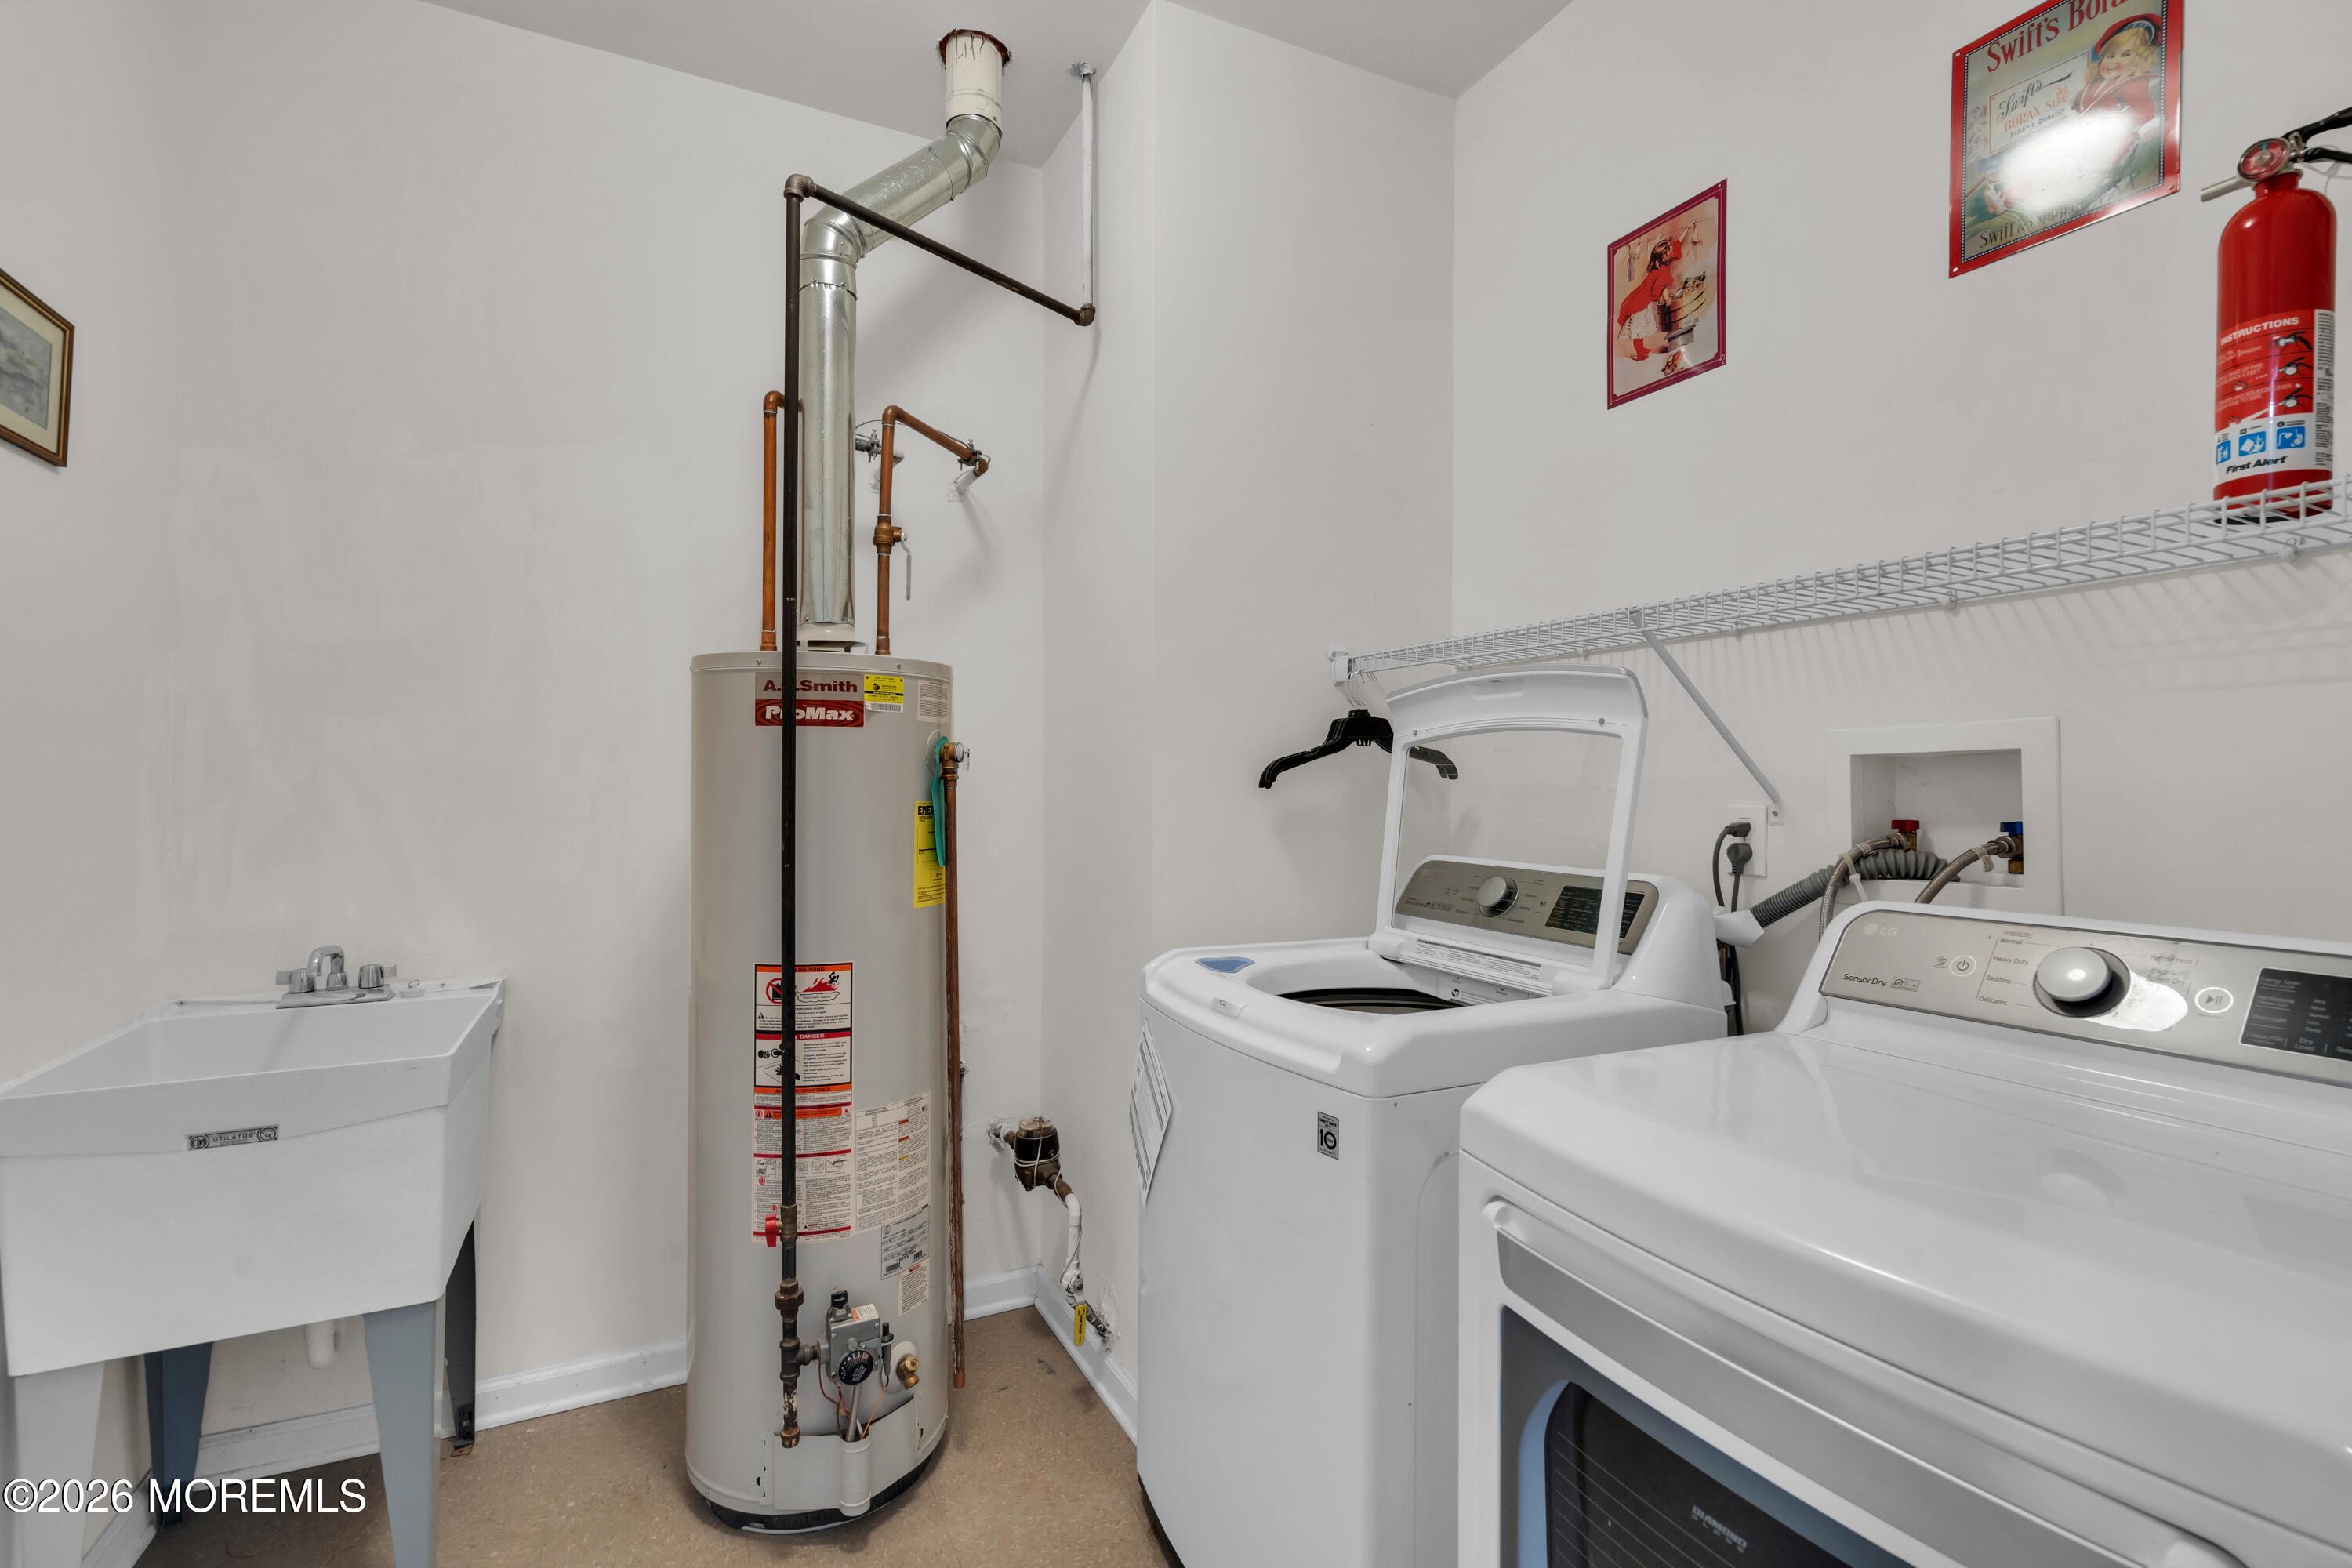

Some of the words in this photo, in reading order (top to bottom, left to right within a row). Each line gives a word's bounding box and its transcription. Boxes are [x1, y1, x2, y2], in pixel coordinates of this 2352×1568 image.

[1987, 17, 2060, 73] Swift's
[2005, 107, 2041, 132] BORAX
[1980, 222, 2014, 249] Swift
[2220, 317, 2300, 346] INSTRUCTIONS
[2226, 461, 2252, 475] First
[2252, 456, 2288, 468] Alert
[764, 706, 855, 720] PoMax
[1880, 925, 1899, 937] LG
[2000, 937, 2024, 946] Normal
[1987, 975, 2012, 985] Bedding
[1978, 994, 2008, 1006] Delicates
[212, 1133, 254, 1142] UTILATUB
[1319, 1128, 1337, 1150] 10
[1692, 1504, 1748, 1549] DIAMOND
